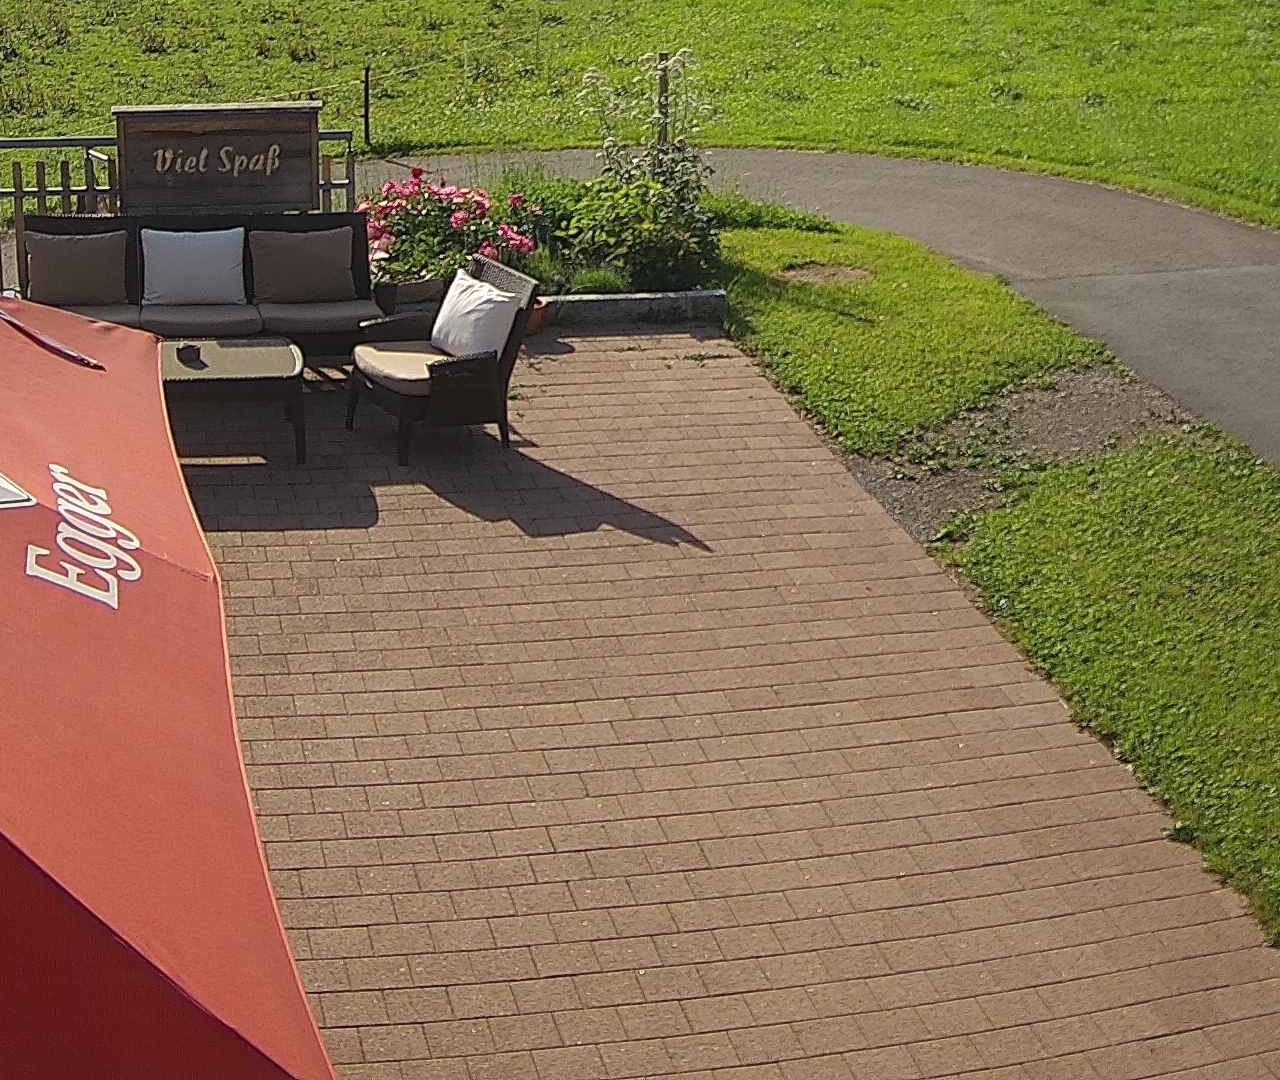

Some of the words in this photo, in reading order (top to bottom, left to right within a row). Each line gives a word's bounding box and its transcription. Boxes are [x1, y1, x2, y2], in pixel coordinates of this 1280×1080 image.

[153, 145, 209, 174] Viel
[218, 144, 281, 177] Spaß
[25, 463, 142, 610] Egger
